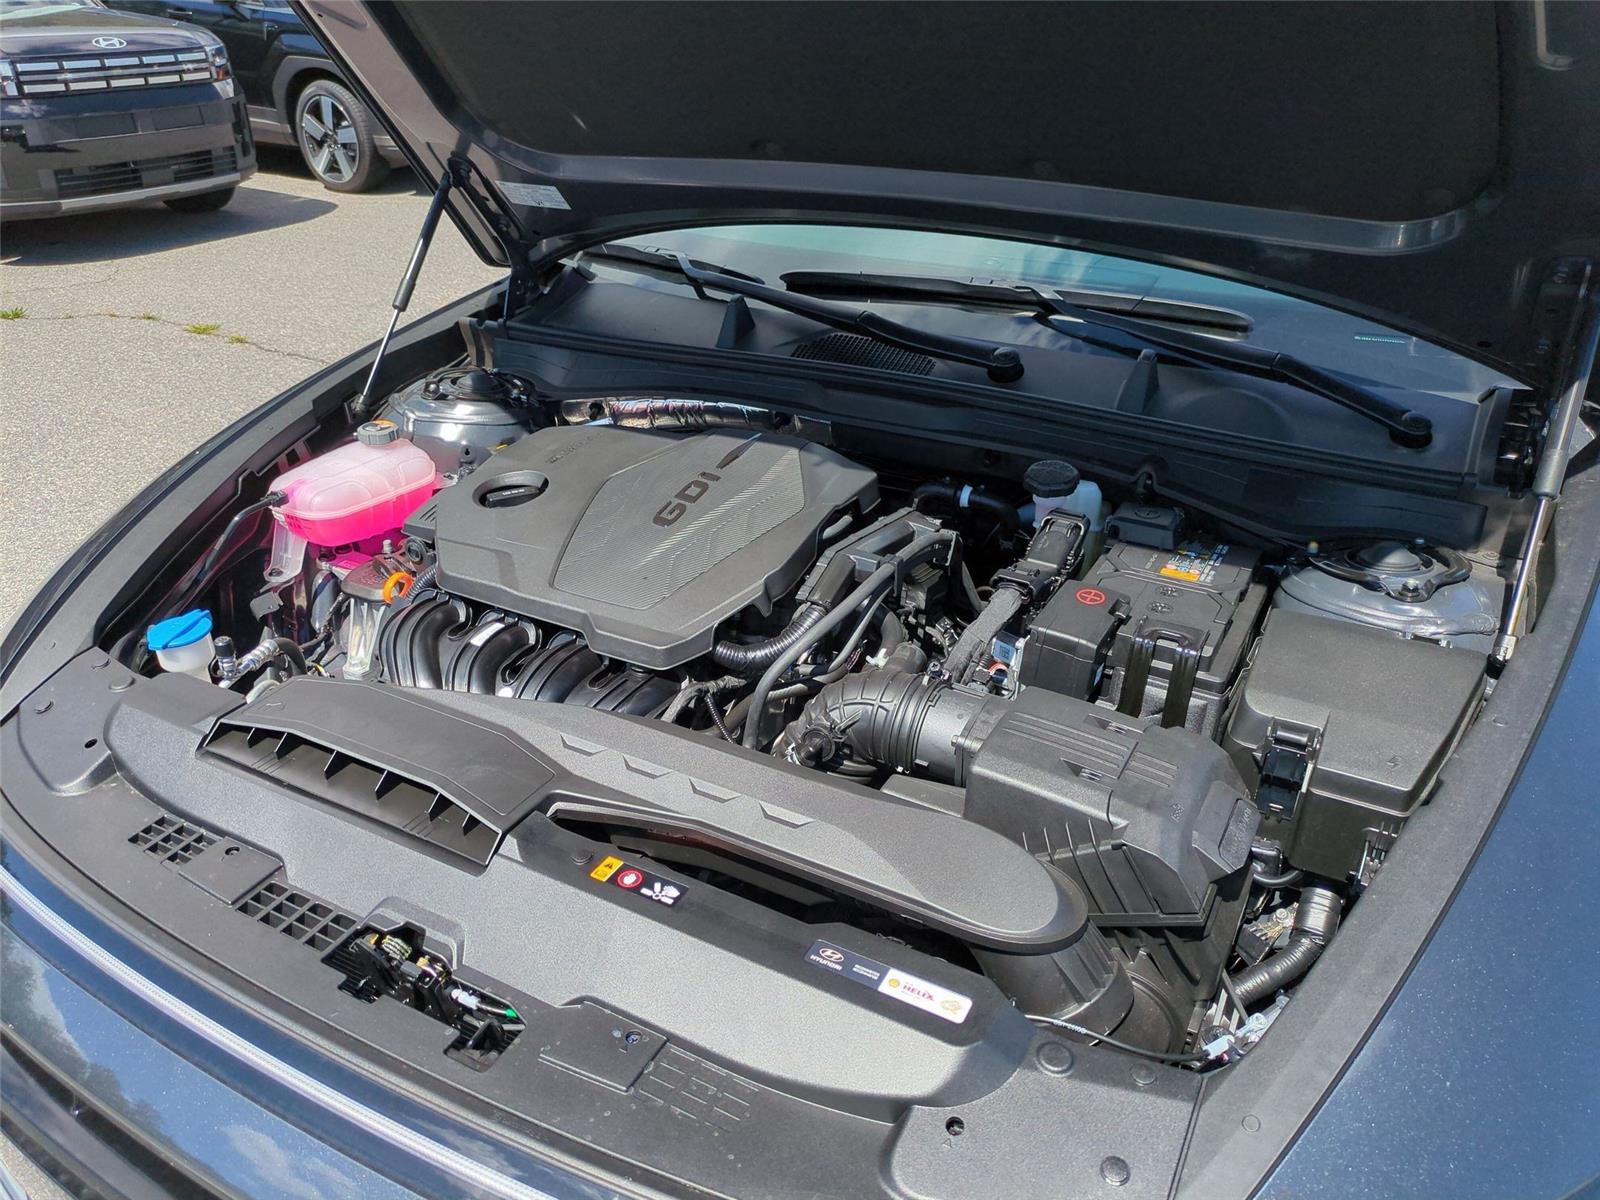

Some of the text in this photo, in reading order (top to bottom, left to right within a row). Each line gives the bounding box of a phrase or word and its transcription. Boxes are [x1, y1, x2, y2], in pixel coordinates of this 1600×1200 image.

[652, 471, 722, 528] GDI
[810, 954, 842, 971] HYUNDAI
[903, 984, 935, 1001] HELIX
